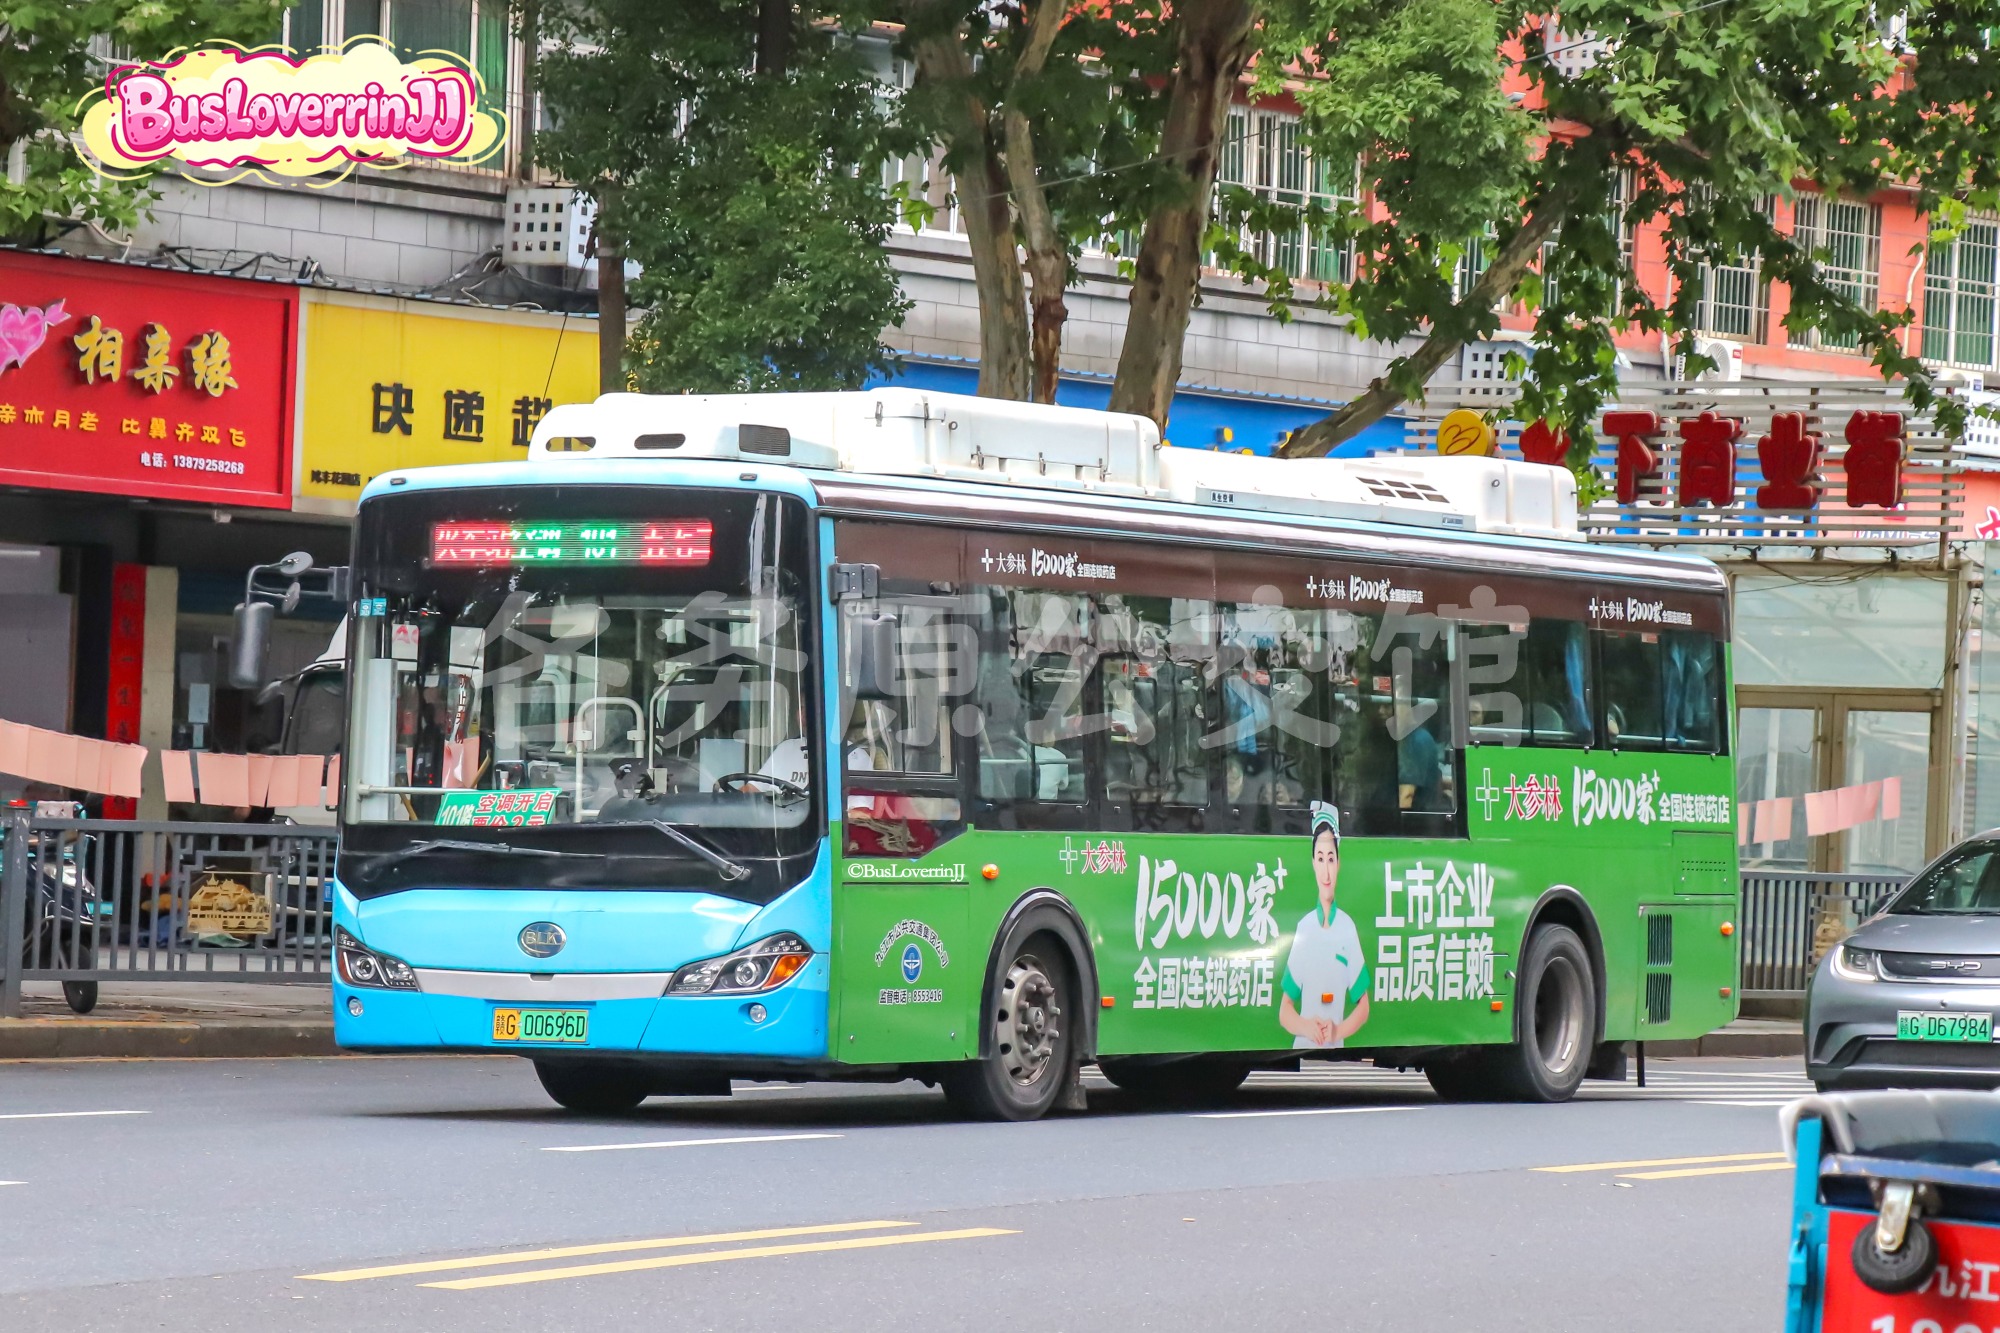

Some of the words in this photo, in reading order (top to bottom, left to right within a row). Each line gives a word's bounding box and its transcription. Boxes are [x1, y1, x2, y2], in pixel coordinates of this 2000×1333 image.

[74, 315, 239, 397] 相亲缘
[996, 552, 1027, 575] 大参林
[1319, 579, 1346, 600] 大参林
[1600, 600, 1624, 620] 大参林
[476, 792, 554, 813] 空调开启
[1504, 773, 1562, 821] 大参林
[1658, 795, 1730, 824] 全国连锁药店
[1081, 840, 1127, 874] 大参林
[1375, 861, 1495, 930] 上市企业
[1133, 954, 1273, 1009] 全国连锁药店
[1374, 932, 1495, 1003] 品质信赖
[1930, 960, 1982, 970] BYD
